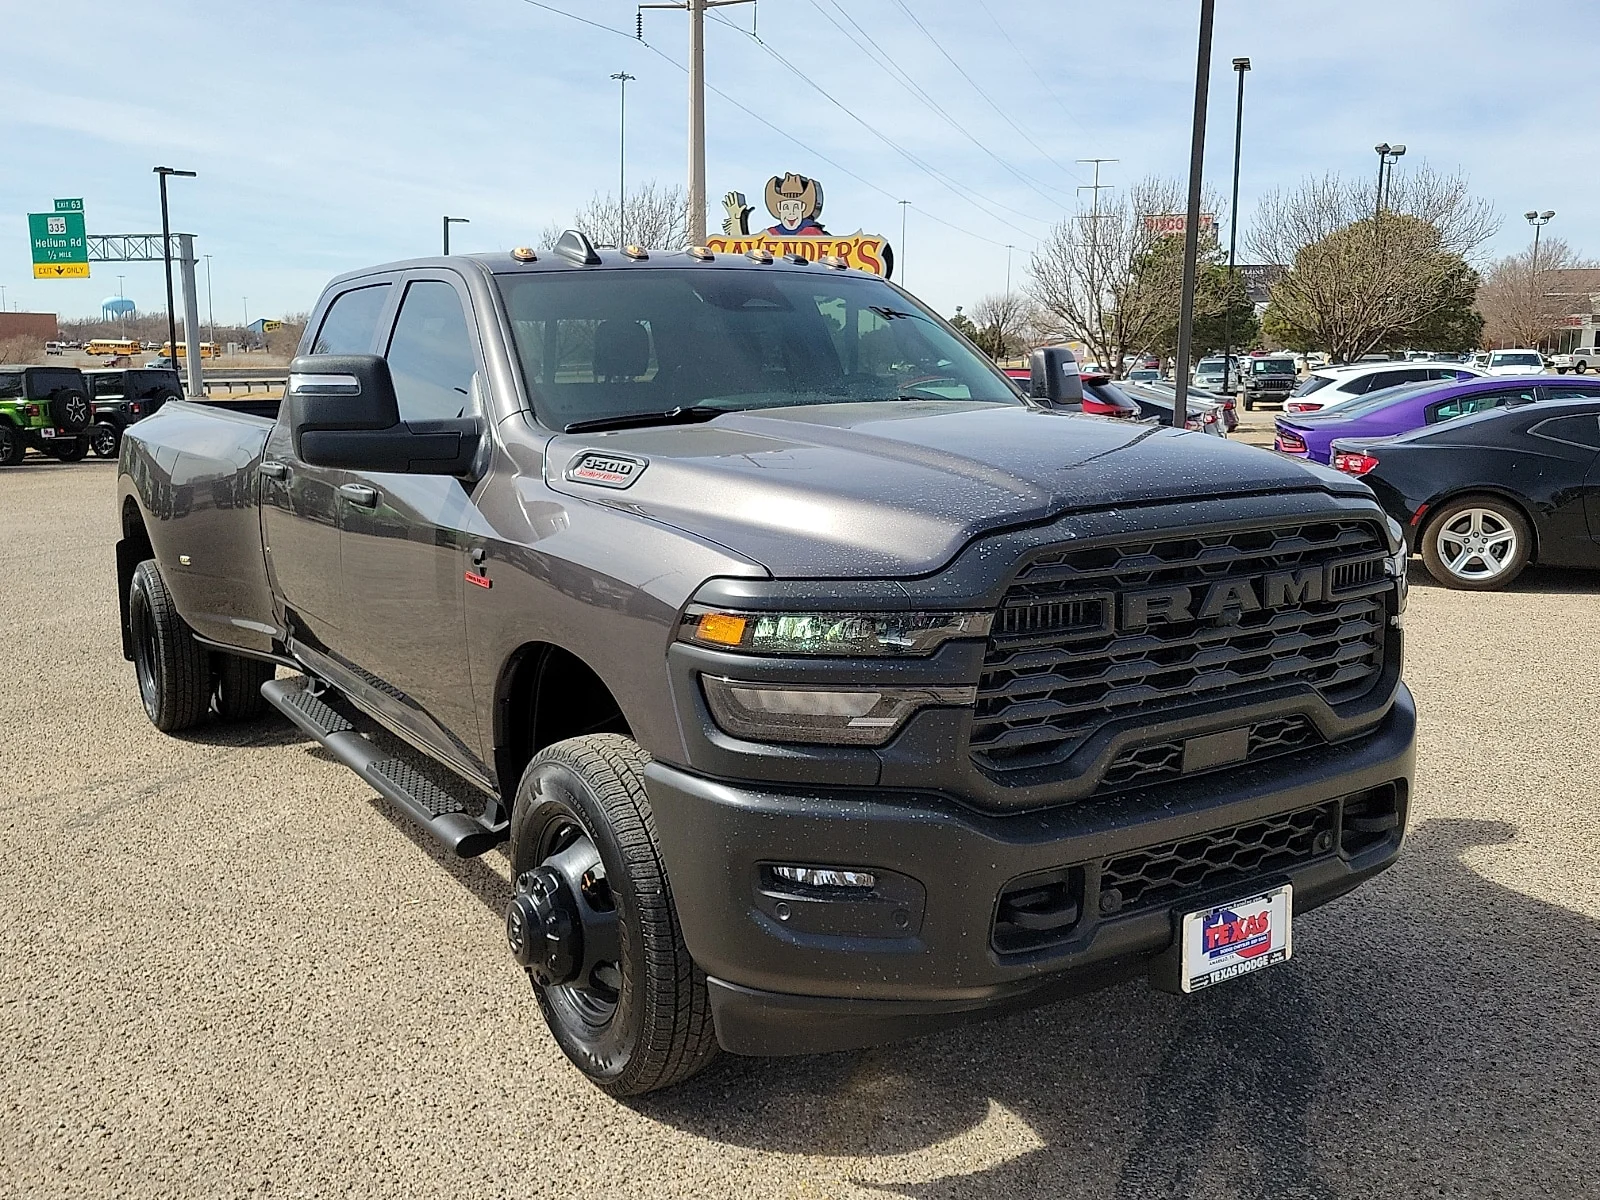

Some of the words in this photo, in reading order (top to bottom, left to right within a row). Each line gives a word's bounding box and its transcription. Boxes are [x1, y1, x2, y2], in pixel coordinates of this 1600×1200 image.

[57, 201, 69, 209] EXIT
[71, 200, 81, 209] 63
[49, 223, 66, 233] 335
[35, 238, 67, 248] Helium
[70, 237, 82, 247] Rd
[66, 266, 84, 274] ONLY
[583, 458, 632, 475] 3500
[1122, 566, 1323, 630] RAM
[1205, 910, 1269, 949] TEXAS
[1209, 964, 1238, 984] TEXAS
[1237, 954, 1269, 974] DODGE
